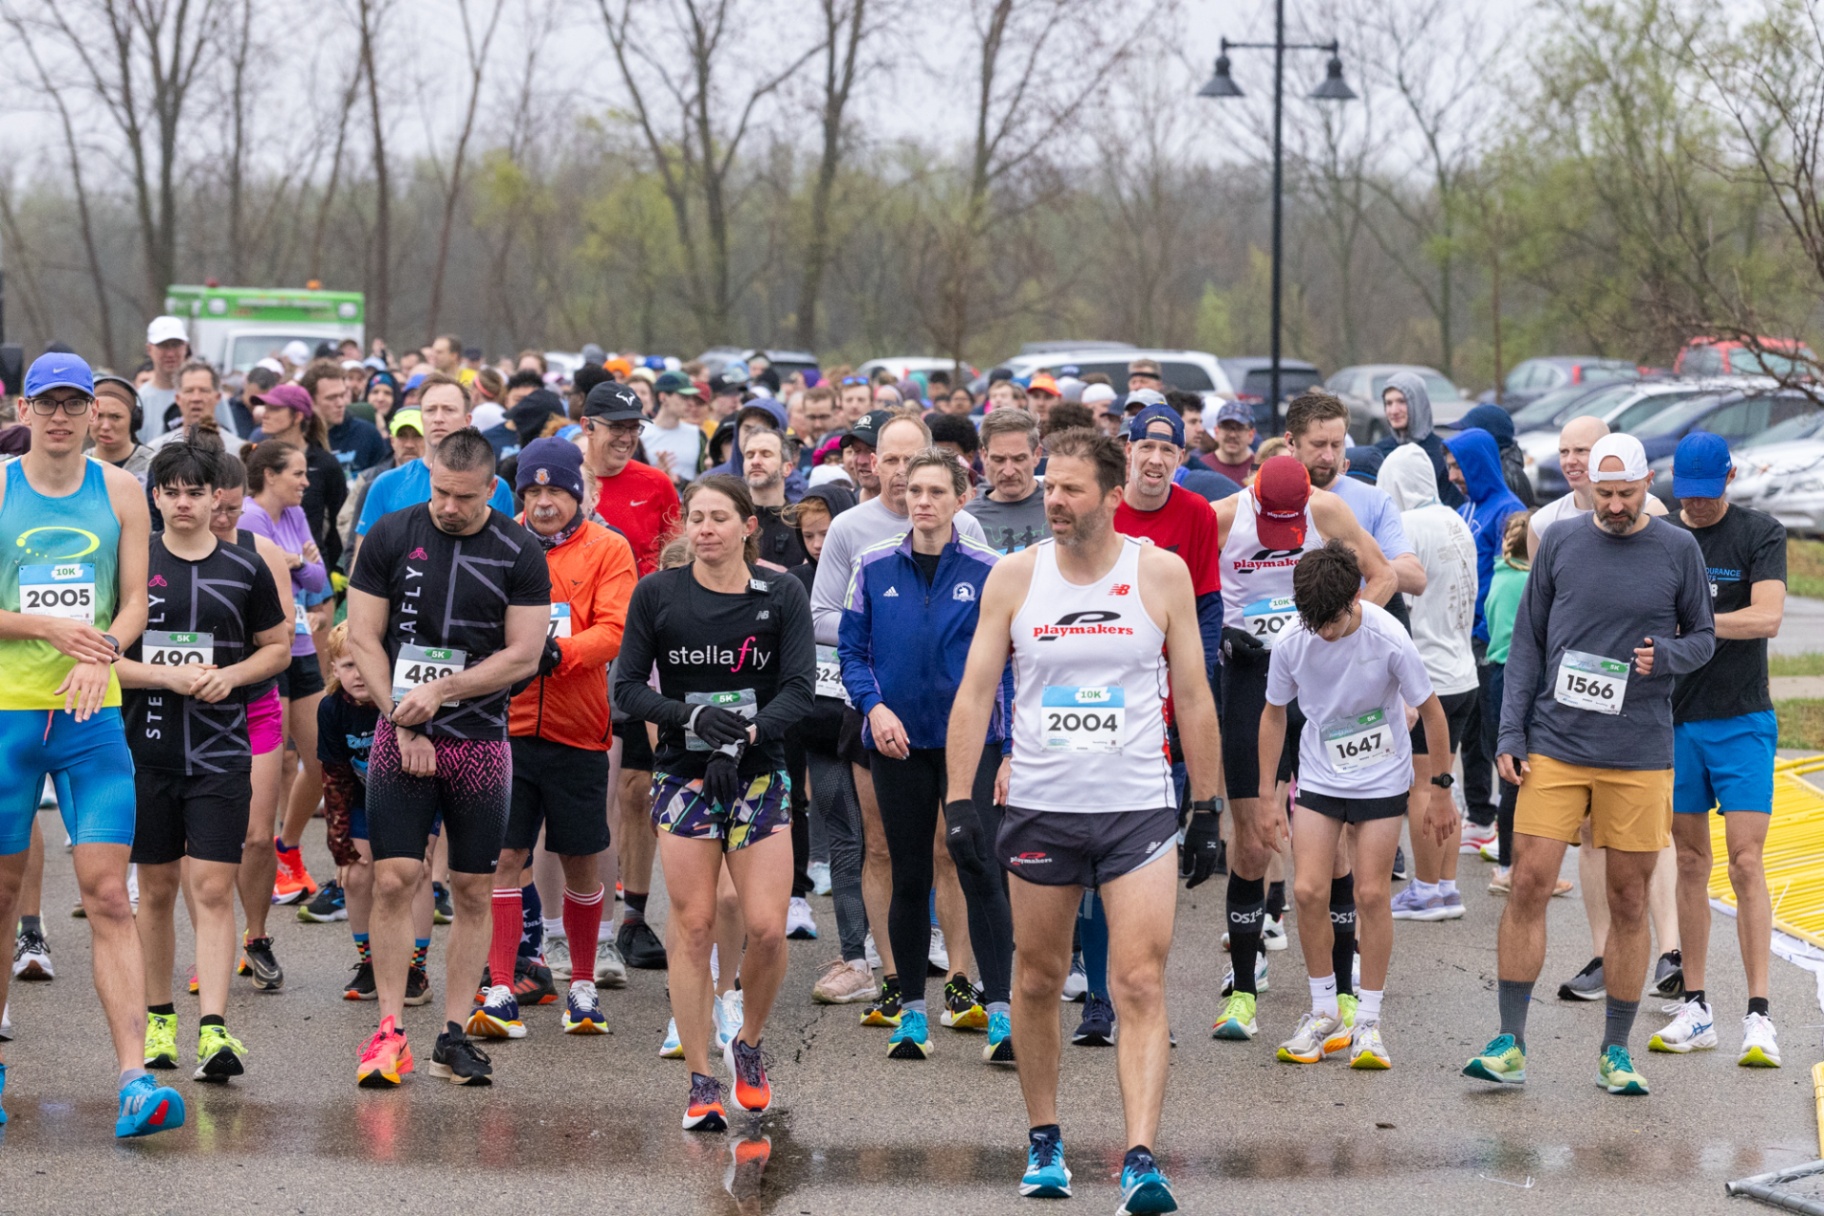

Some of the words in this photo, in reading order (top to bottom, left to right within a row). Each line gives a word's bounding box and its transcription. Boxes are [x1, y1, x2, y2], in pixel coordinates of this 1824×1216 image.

[56, 567, 76, 576] 10K
[26, 588, 91, 608] 2005
[1033, 623, 1134, 637] playmakers
[176, 634, 191, 642] 5K
[431, 650, 445, 658] 5K
[668, 635, 771, 673] stellafly
[1567, 673, 1614, 700] 1566
[719, 694, 734, 703] 5K
[1080, 690, 1102, 699] 10K
[1048, 713, 1118, 732] 2004
[1336, 732, 1382, 759] 1647
